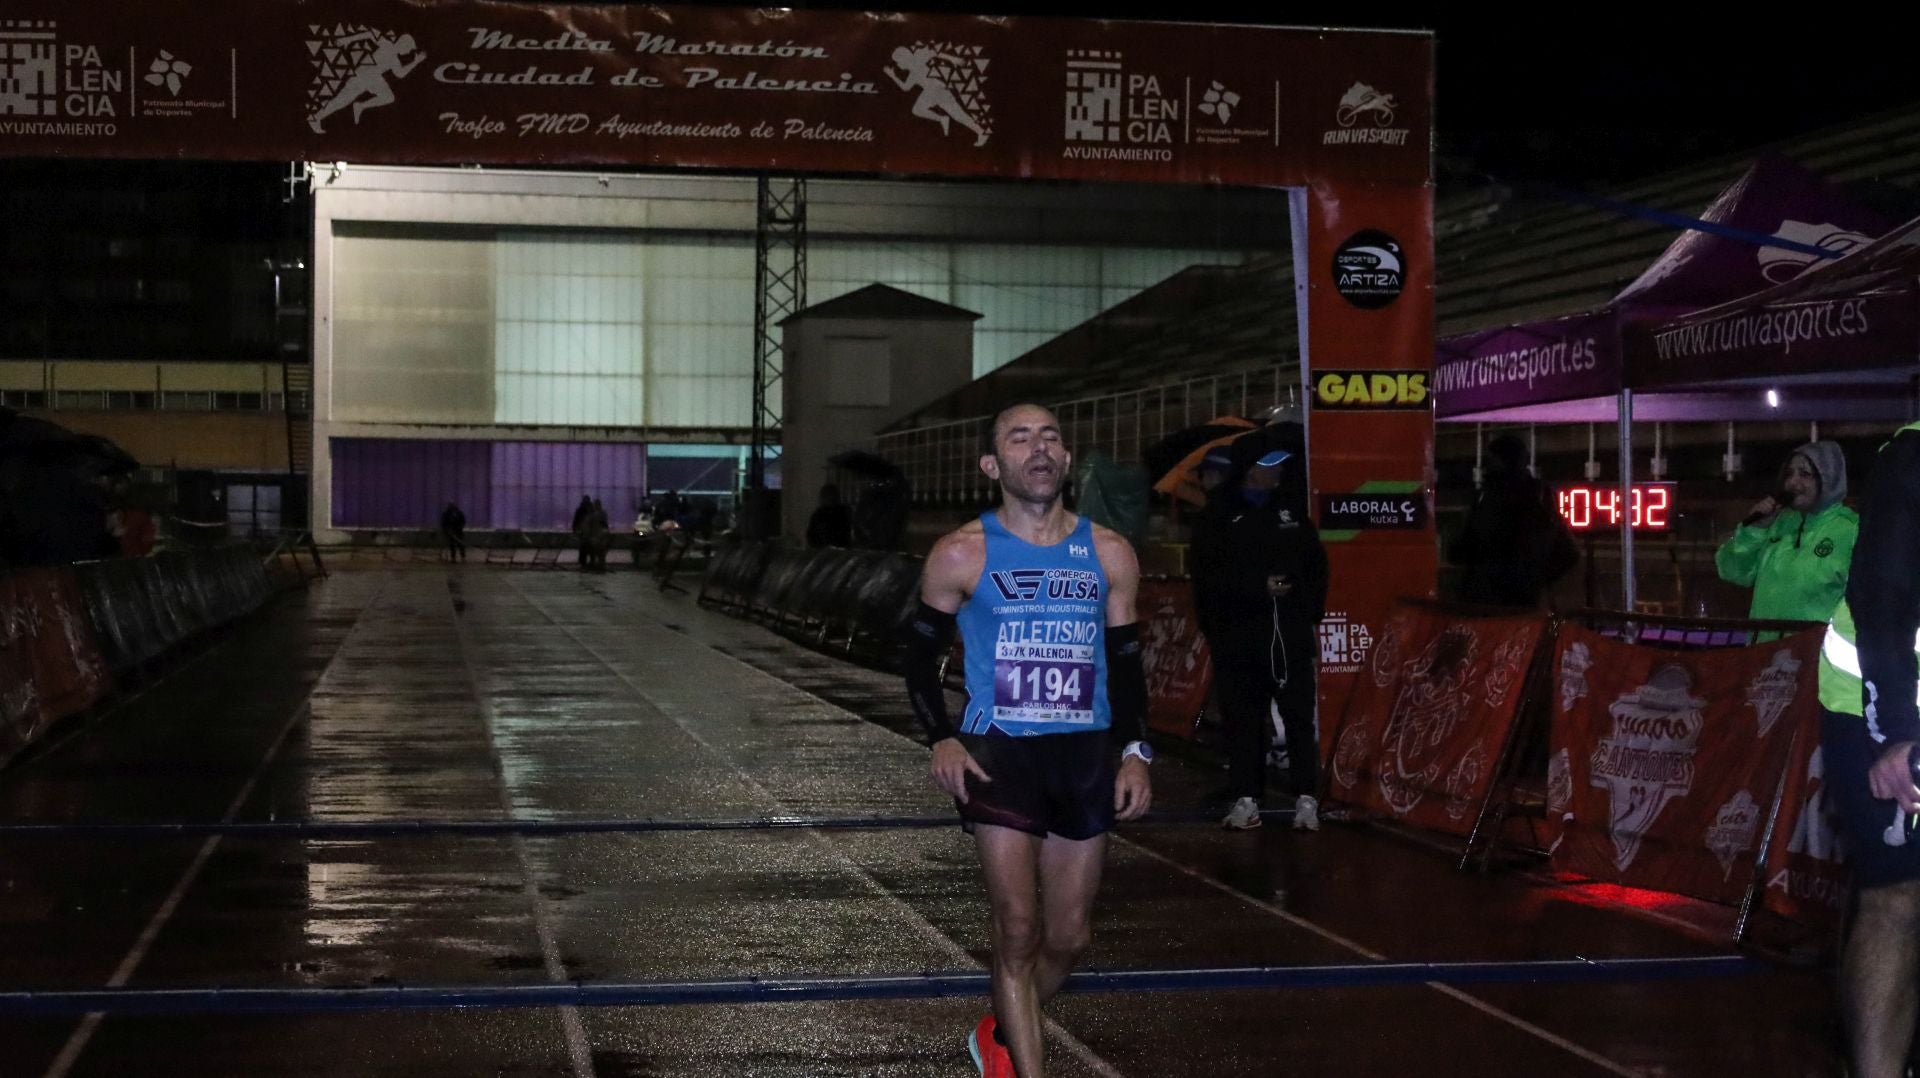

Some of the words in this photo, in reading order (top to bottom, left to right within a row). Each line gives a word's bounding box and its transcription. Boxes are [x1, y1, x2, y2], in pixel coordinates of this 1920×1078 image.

[467, 27, 616, 51] Media
[632, 31, 830, 59] Maratón
[65, 44, 103, 67] PA
[65, 69, 122, 92] LEN
[433, 62, 596, 85] Ciudad
[610, 67, 664, 88] de
[683, 67, 879, 95] Palencia
[1128, 74, 1161, 96] PA
[64, 93, 116, 117] CIA
[1128, 98, 1178, 120] LEN
[438, 111, 506, 140] Trofeo
[515, 112, 591, 138] FMD
[595, 113, 742, 140] Ayuntamiento
[750, 120, 775, 139] de
[783, 118, 876, 142] Palencia
[1127, 121, 1172, 143] CIA
[1063, 146, 1172, 161] AYUNTAMIENTO
[1339, 273, 1399, 286] ARTIZA
[1655, 298, 1869, 360] www.runvasport.es
[1433, 337, 1596, 394] www.runvasport.es
[1317, 373, 1427, 404] GADIS
[1331, 501, 1398, 514] LABORAL
[1370, 514, 1399, 524] kutxa
[1069, 544, 1088, 556] HH
[1047, 570, 1098, 581] COMERCIAL
[1047, 579, 1099, 601] ULSA
[992, 605, 1046, 615] SUMINISTROS
[998, 620, 1098, 644] ATLETISMO
[1350, 624, 1369, 636] PA
[1028, 647, 1073, 659] PALENCIA
[1350, 650, 1366, 662] CI
[1007, 666, 1081, 702] 1194
[1022, 702, 1055, 710] CARLOS
